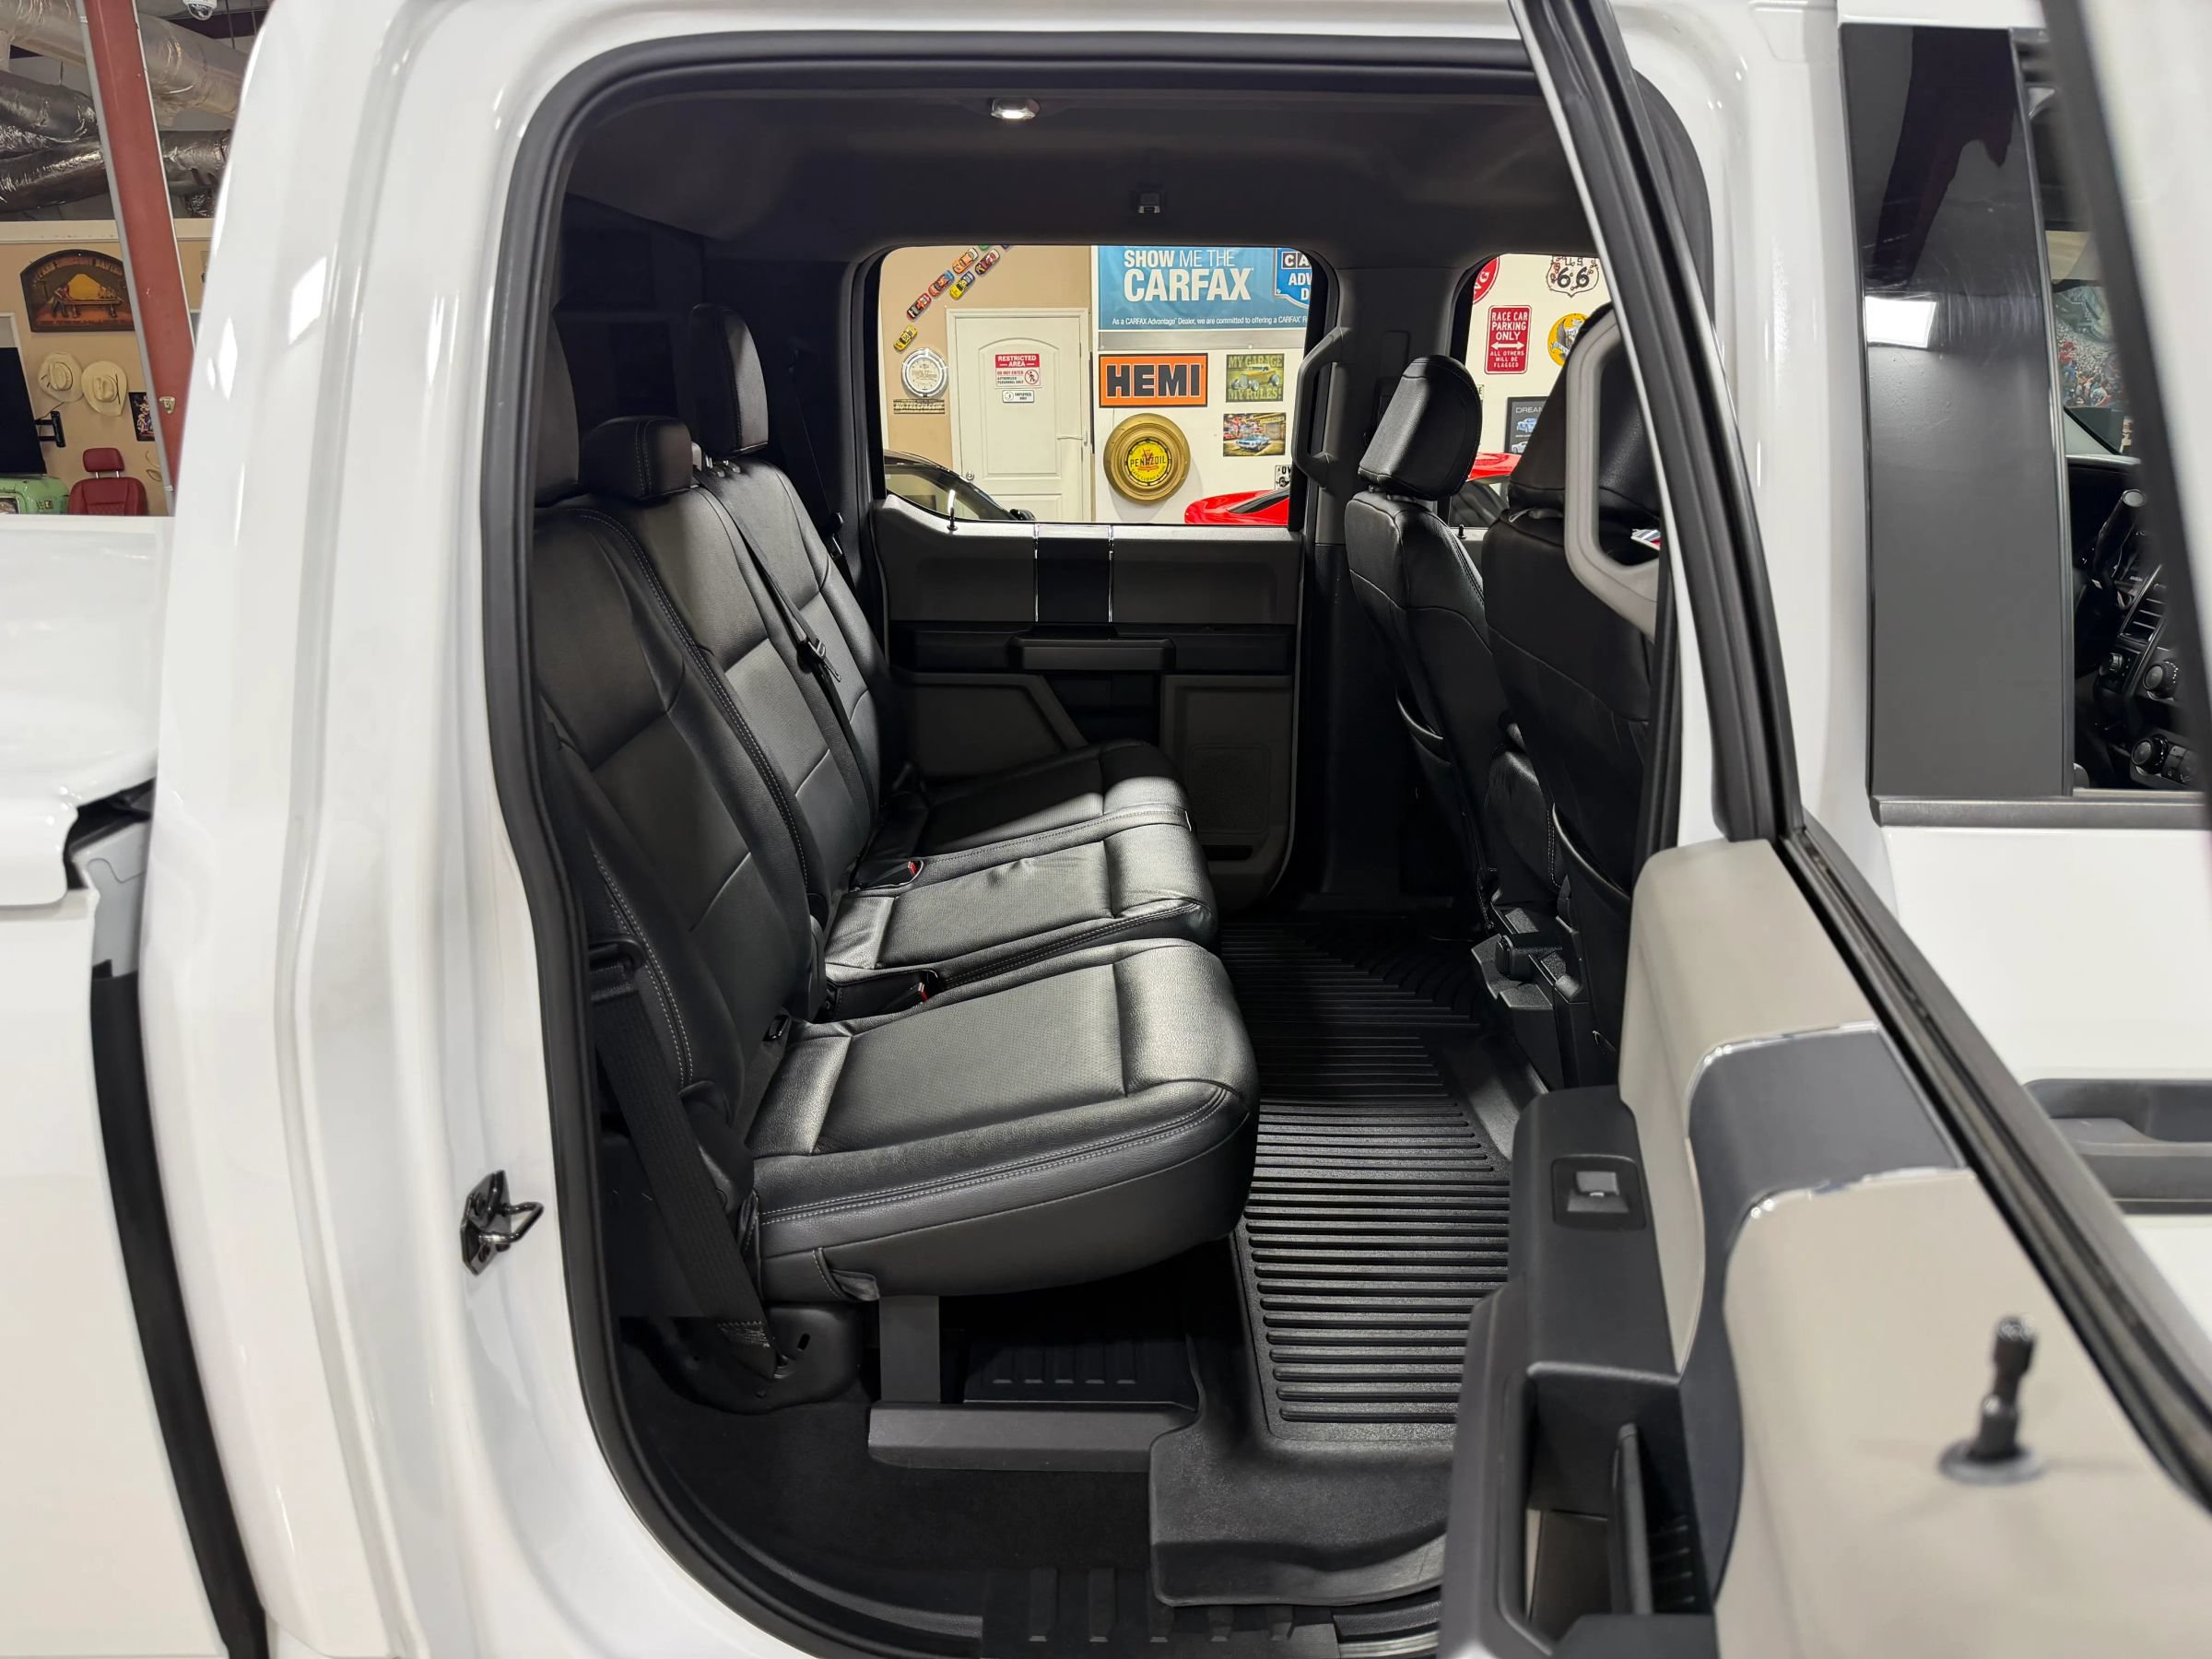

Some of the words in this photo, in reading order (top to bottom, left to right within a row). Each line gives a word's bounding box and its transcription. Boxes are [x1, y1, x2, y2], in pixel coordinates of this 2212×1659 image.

[1124, 250, 1174, 267] SHOW
[1179, 251, 1202, 266] ME
[1206, 250, 1235, 266] THE
[1124, 268, 1252, 301] CARFAX
[1125, 317, 1147, 325] CARFAX
[1252, 316, 1272, 325] offering
[1492, 312, 1512, 322] RACE
[1513, 312, 1528, 322] CAR
[1491, 322, 1526, 331] PARKING
[1496, 332, 1521, 341] ONLY
[1229, 356, 1243, 368] MY
[1245, 355, 1282, 368] GARAGE
[1106, 364, 1201, 397] HEMI
[1228, 389, 1244, 400] MY
[1246, 387, 1282, 400] RULES!
